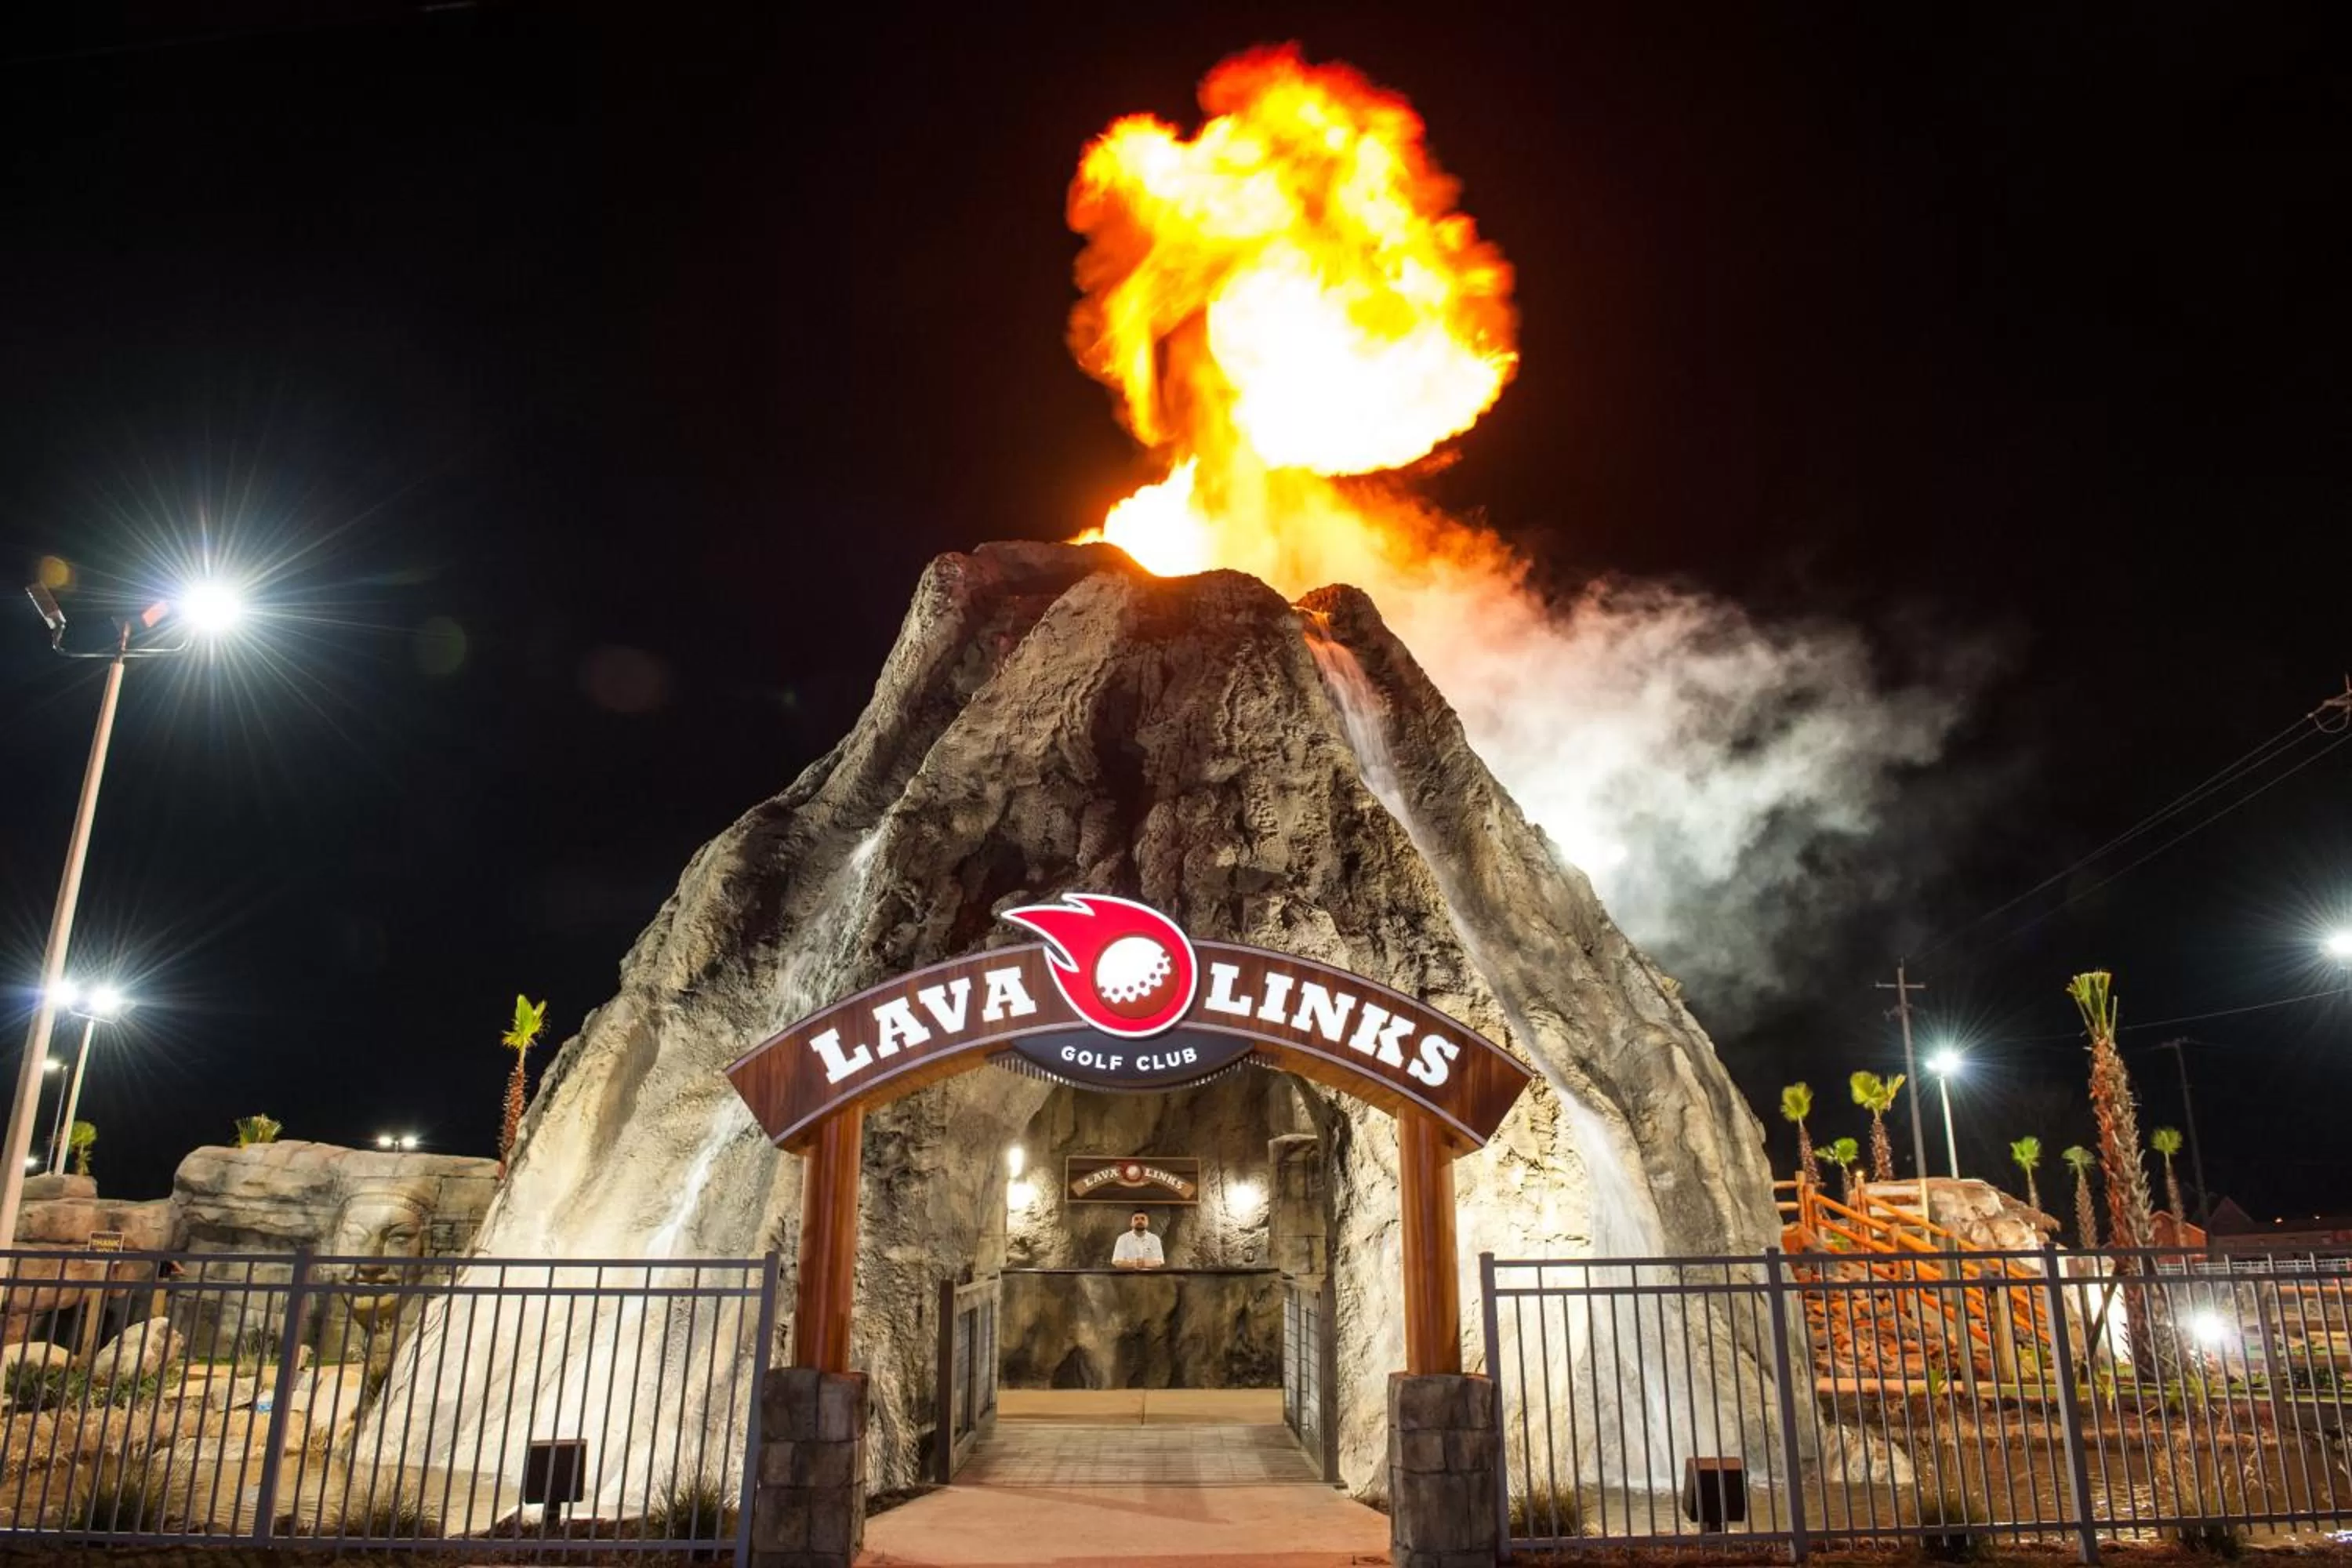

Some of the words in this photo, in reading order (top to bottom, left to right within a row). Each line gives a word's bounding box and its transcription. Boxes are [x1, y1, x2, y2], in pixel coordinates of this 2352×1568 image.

[809, 966, 1036, 1084] LAVA
[1204, 962, 1461, 1087] LINKS
[1061, 1045, 1123, 1070] GOLF
[1136, 1047, 1198, 1071] CLUB
[1084, 1167, 1119, 1187] LAVA
[1144, 1167, 1185, 1189] LINKS
